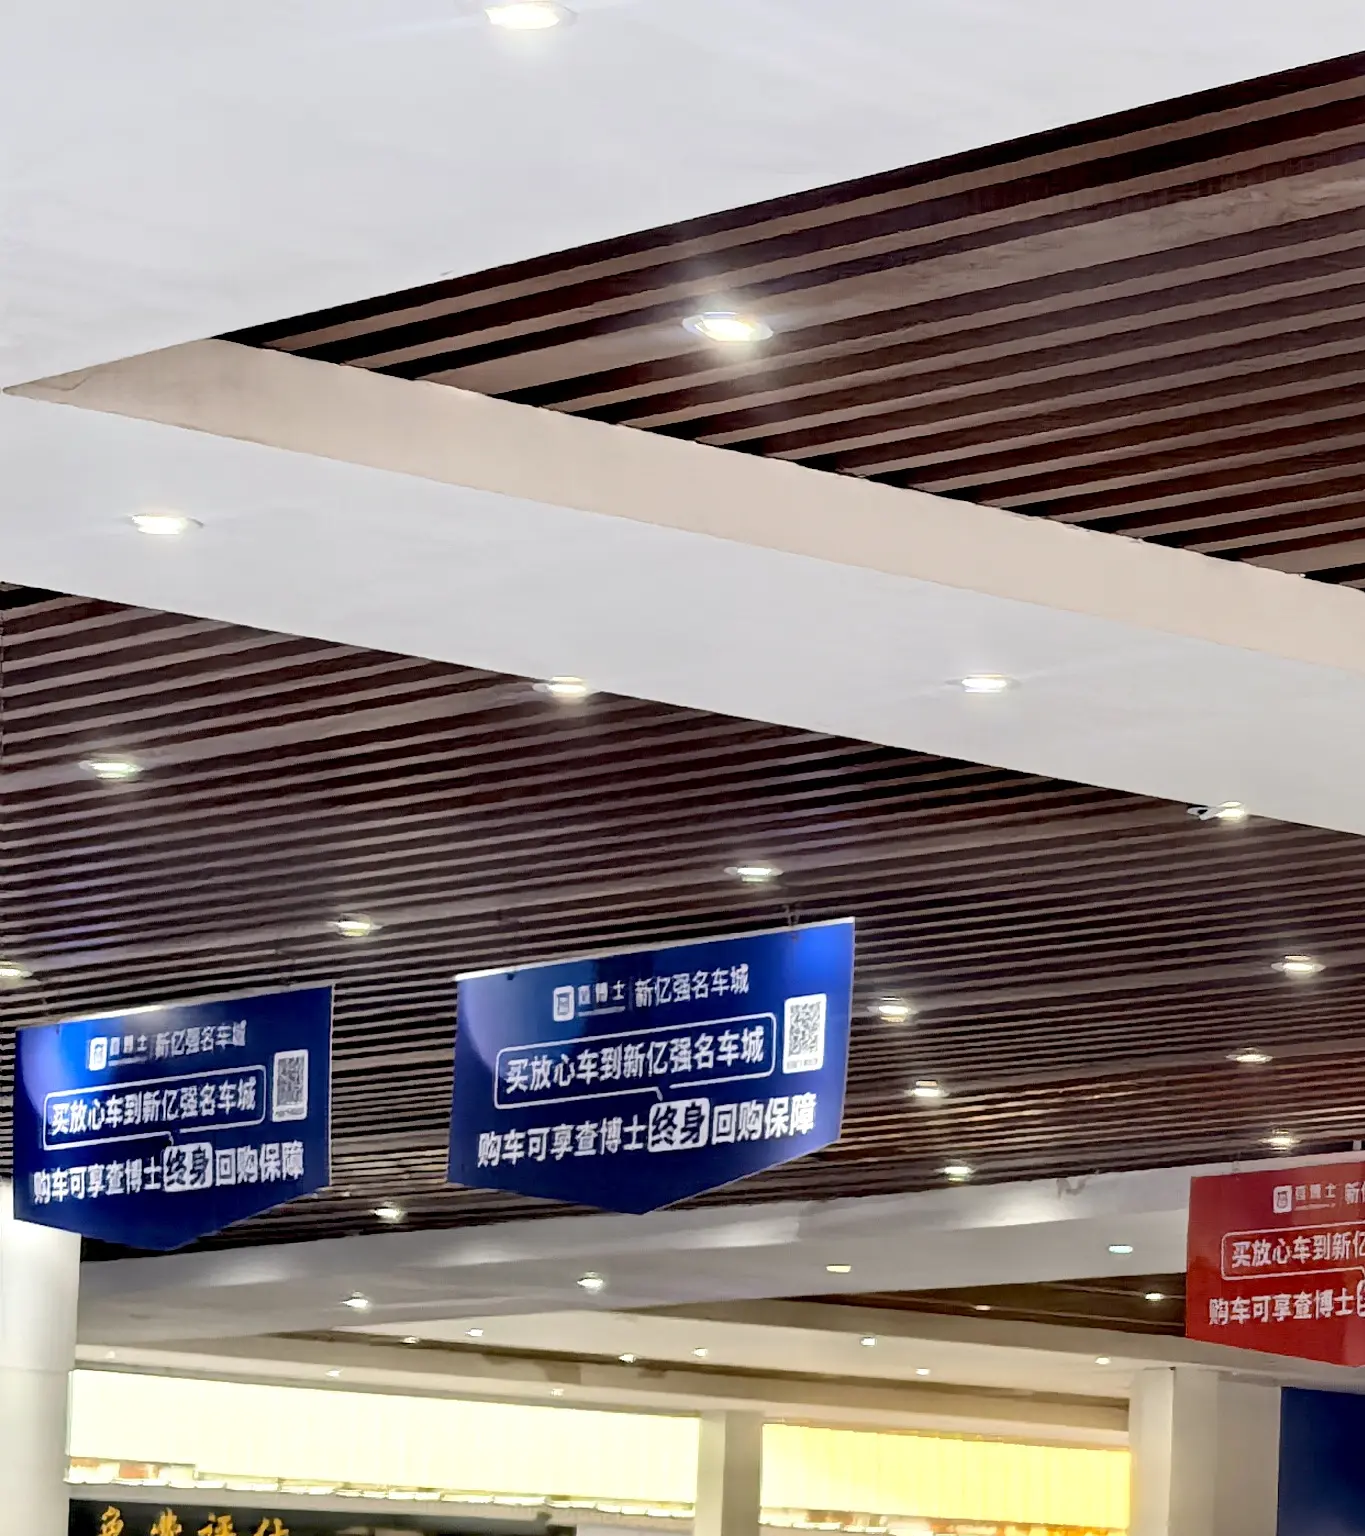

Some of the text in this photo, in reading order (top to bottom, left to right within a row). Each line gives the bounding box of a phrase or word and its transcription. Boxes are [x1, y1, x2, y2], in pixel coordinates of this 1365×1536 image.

[634, 963, 750, 1008] 新亿强名车城
[504, 1025, 765, 1094] 买放心车到新亿强名车城
[50, 1075, 257, 1136] 买放心车到新亿强名车城
[476, 1091, 818, 1168] 购车可享查博士终身回购保障
[32, 1141, 305, 1206] 购车可享查博士终身回购保障
